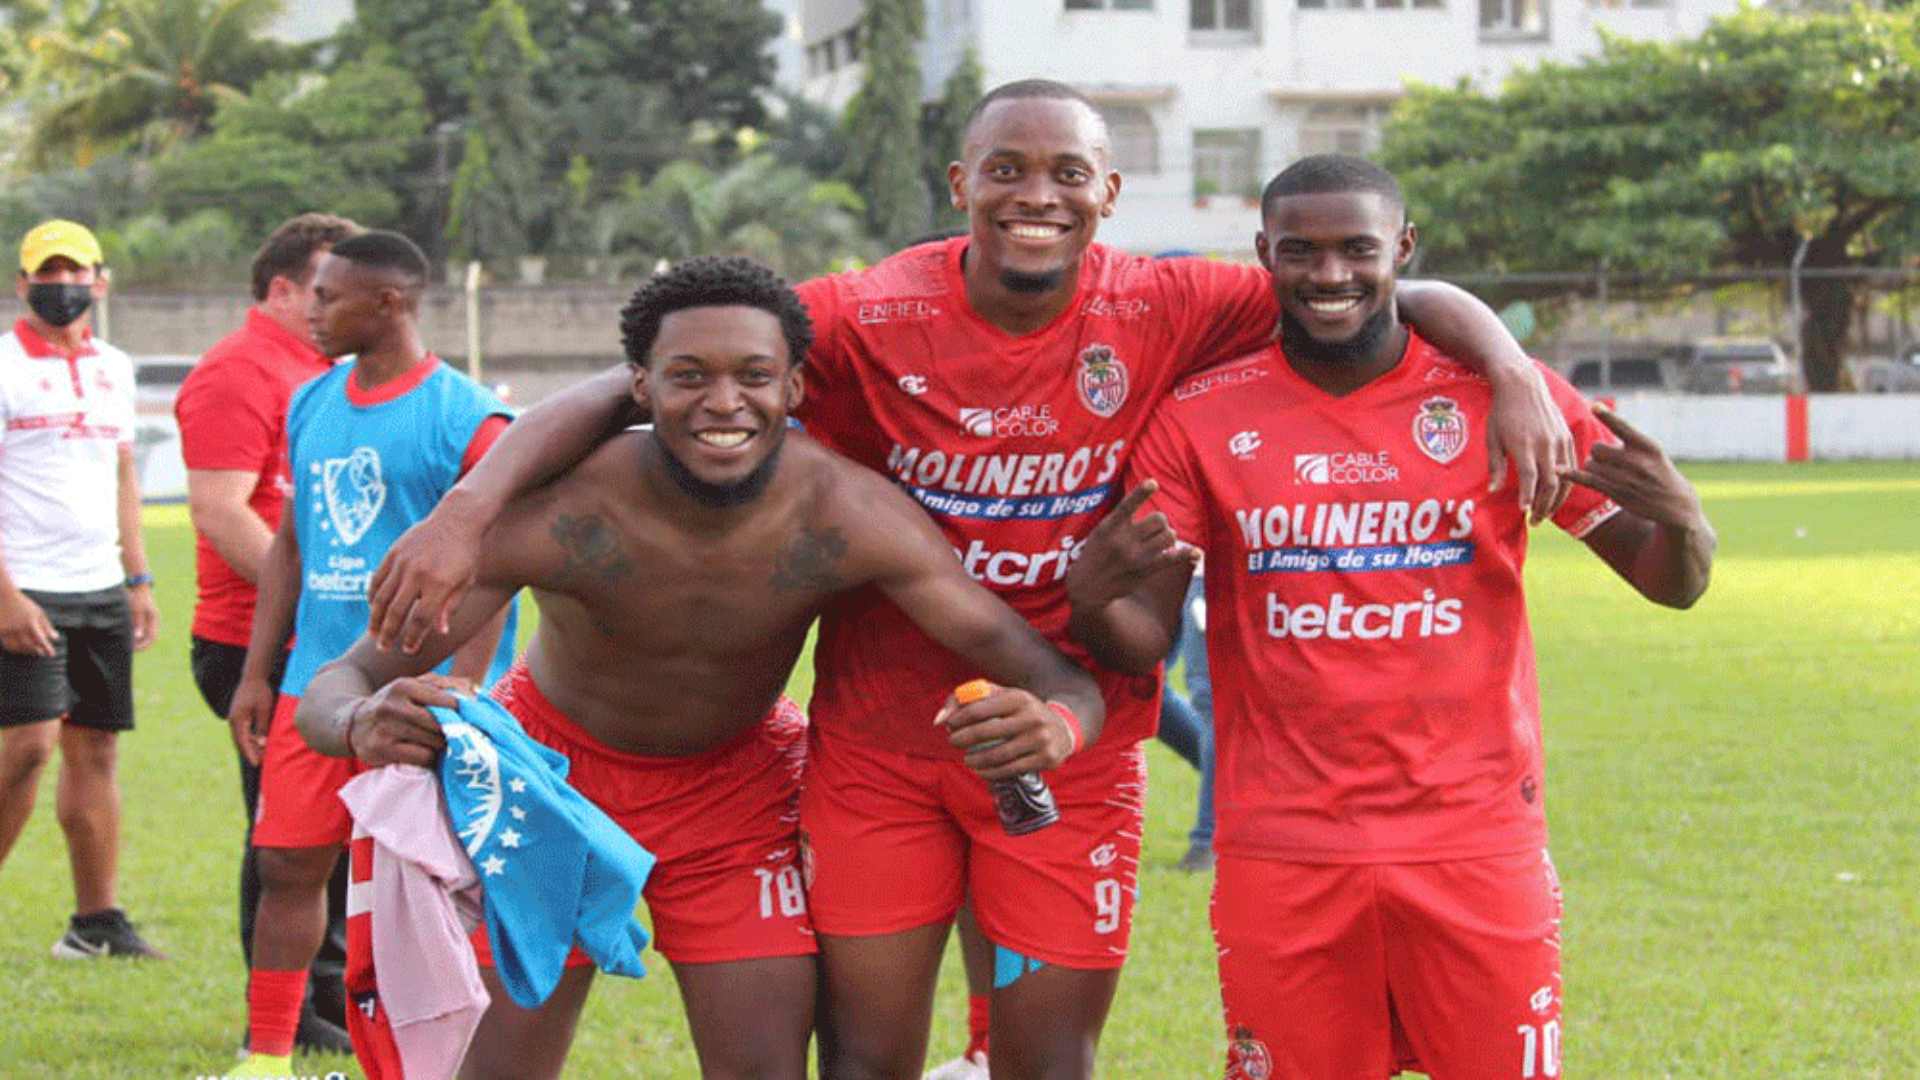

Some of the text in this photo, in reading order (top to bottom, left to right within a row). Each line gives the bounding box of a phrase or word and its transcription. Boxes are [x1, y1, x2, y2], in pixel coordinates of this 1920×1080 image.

[995, 405, 1051, 422] CABLE
[996, 420, 1060, 438] COLOR
[886, 440, 1125, 495] MOLINERO'S
[1330, 451, 1390, 468] CABLE
[1330, 467, 1400, 485] COLOR
[985, 499, 1015, 518] de
[1019, 500, 1043, 516] su
[1235, 498, 1475, 550] MOLINERO'S
[1247, 544, 1466, 572] El Amigo de su Hogar
[1266, 588, 1463, 641] betcris
[753, 865, 806, 918] 18
[1093, 879, 1121, 934] 9
[1516, 1019, 1562, 1078] 10
